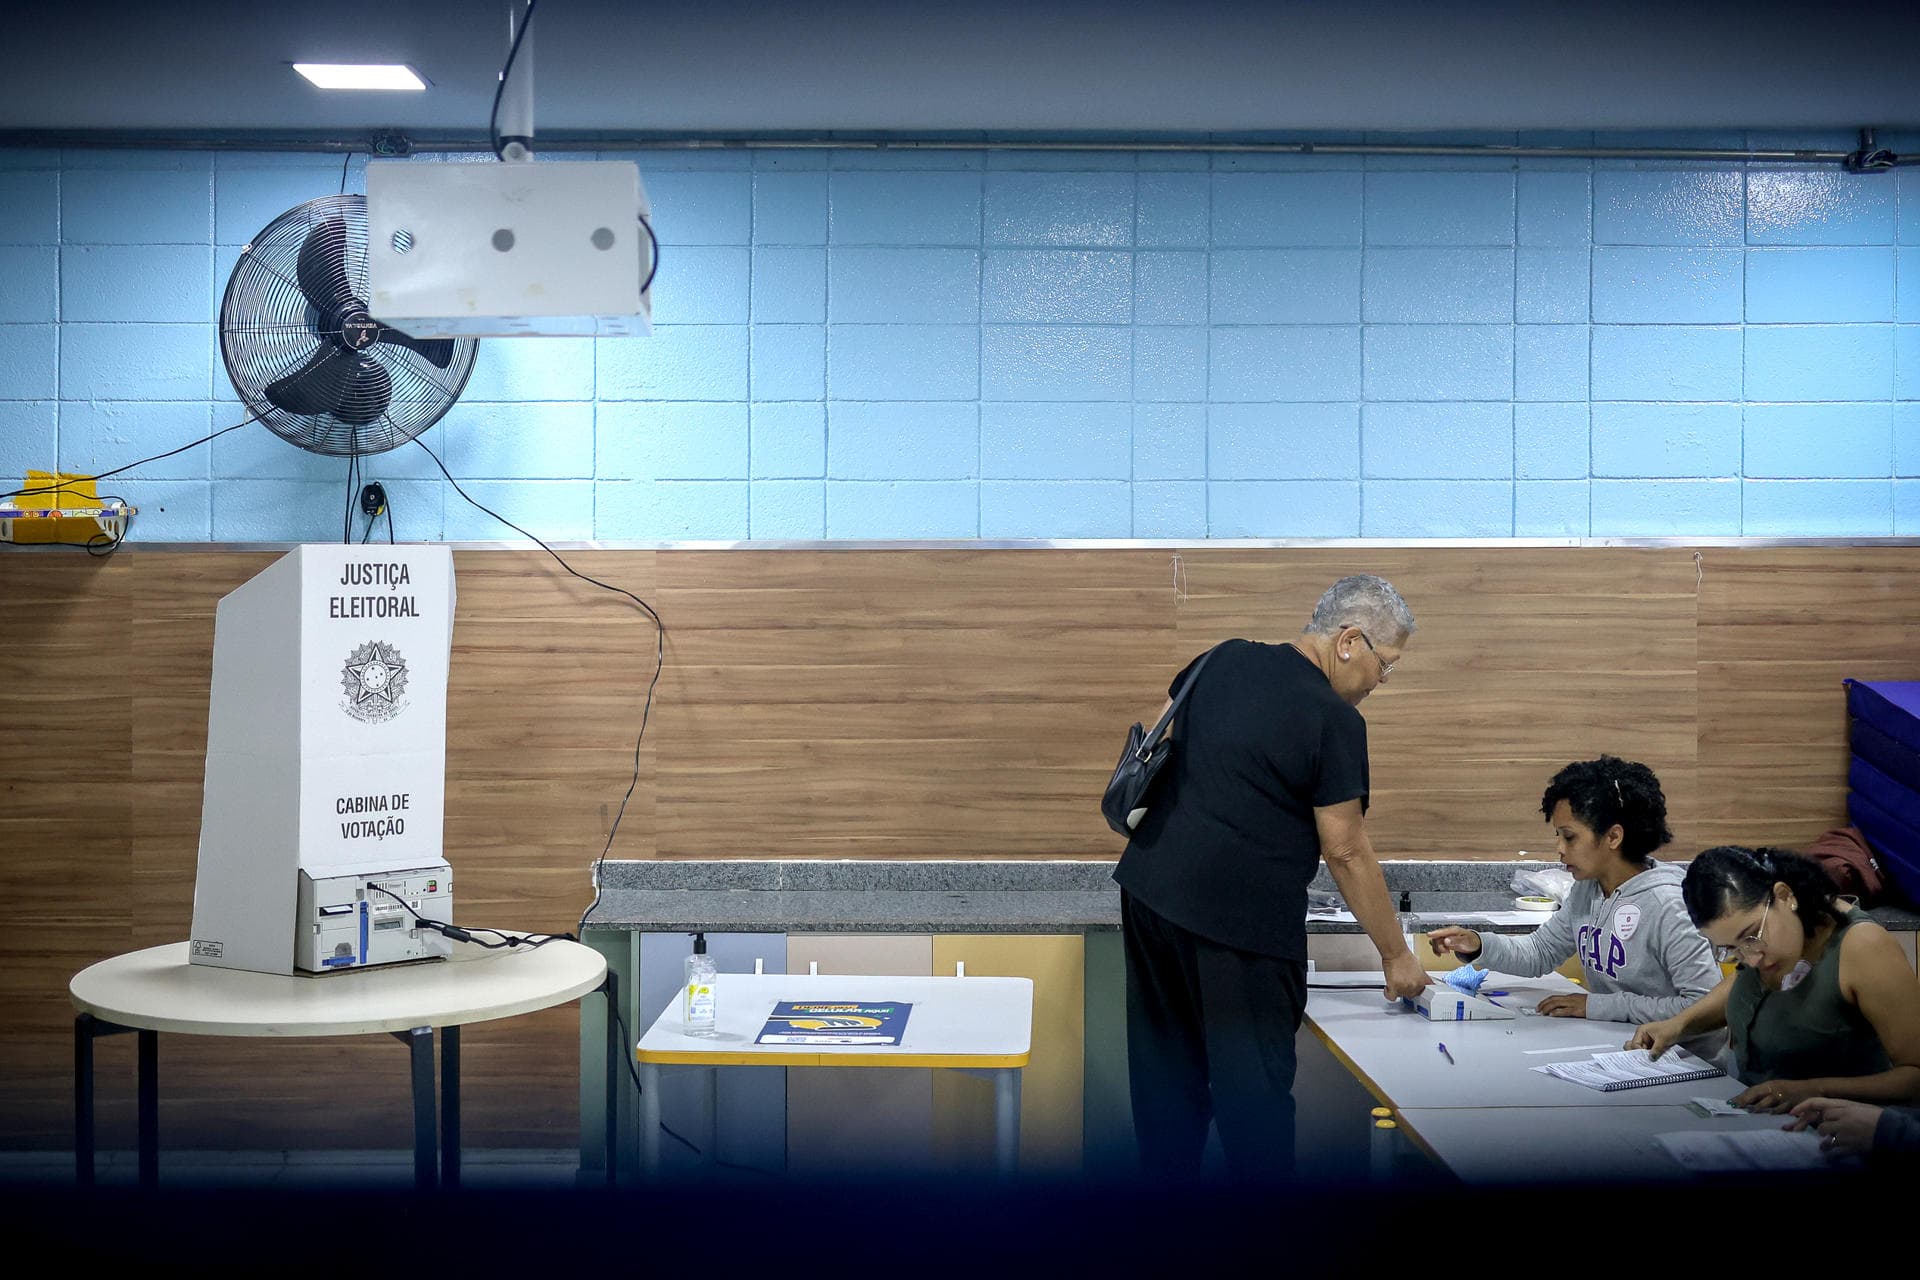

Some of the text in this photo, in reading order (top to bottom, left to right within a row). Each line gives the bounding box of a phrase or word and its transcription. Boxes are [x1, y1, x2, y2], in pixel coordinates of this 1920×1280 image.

[340, 563, 410, 591] JUSTIÇA
[330, 596, 420, 618] ELEITORAL
[336, 793, 410, 814] CABINA DE
[341, 815, 404, 841] VOTAÇÃO
[1578, 925, 1626, 980] GAP
